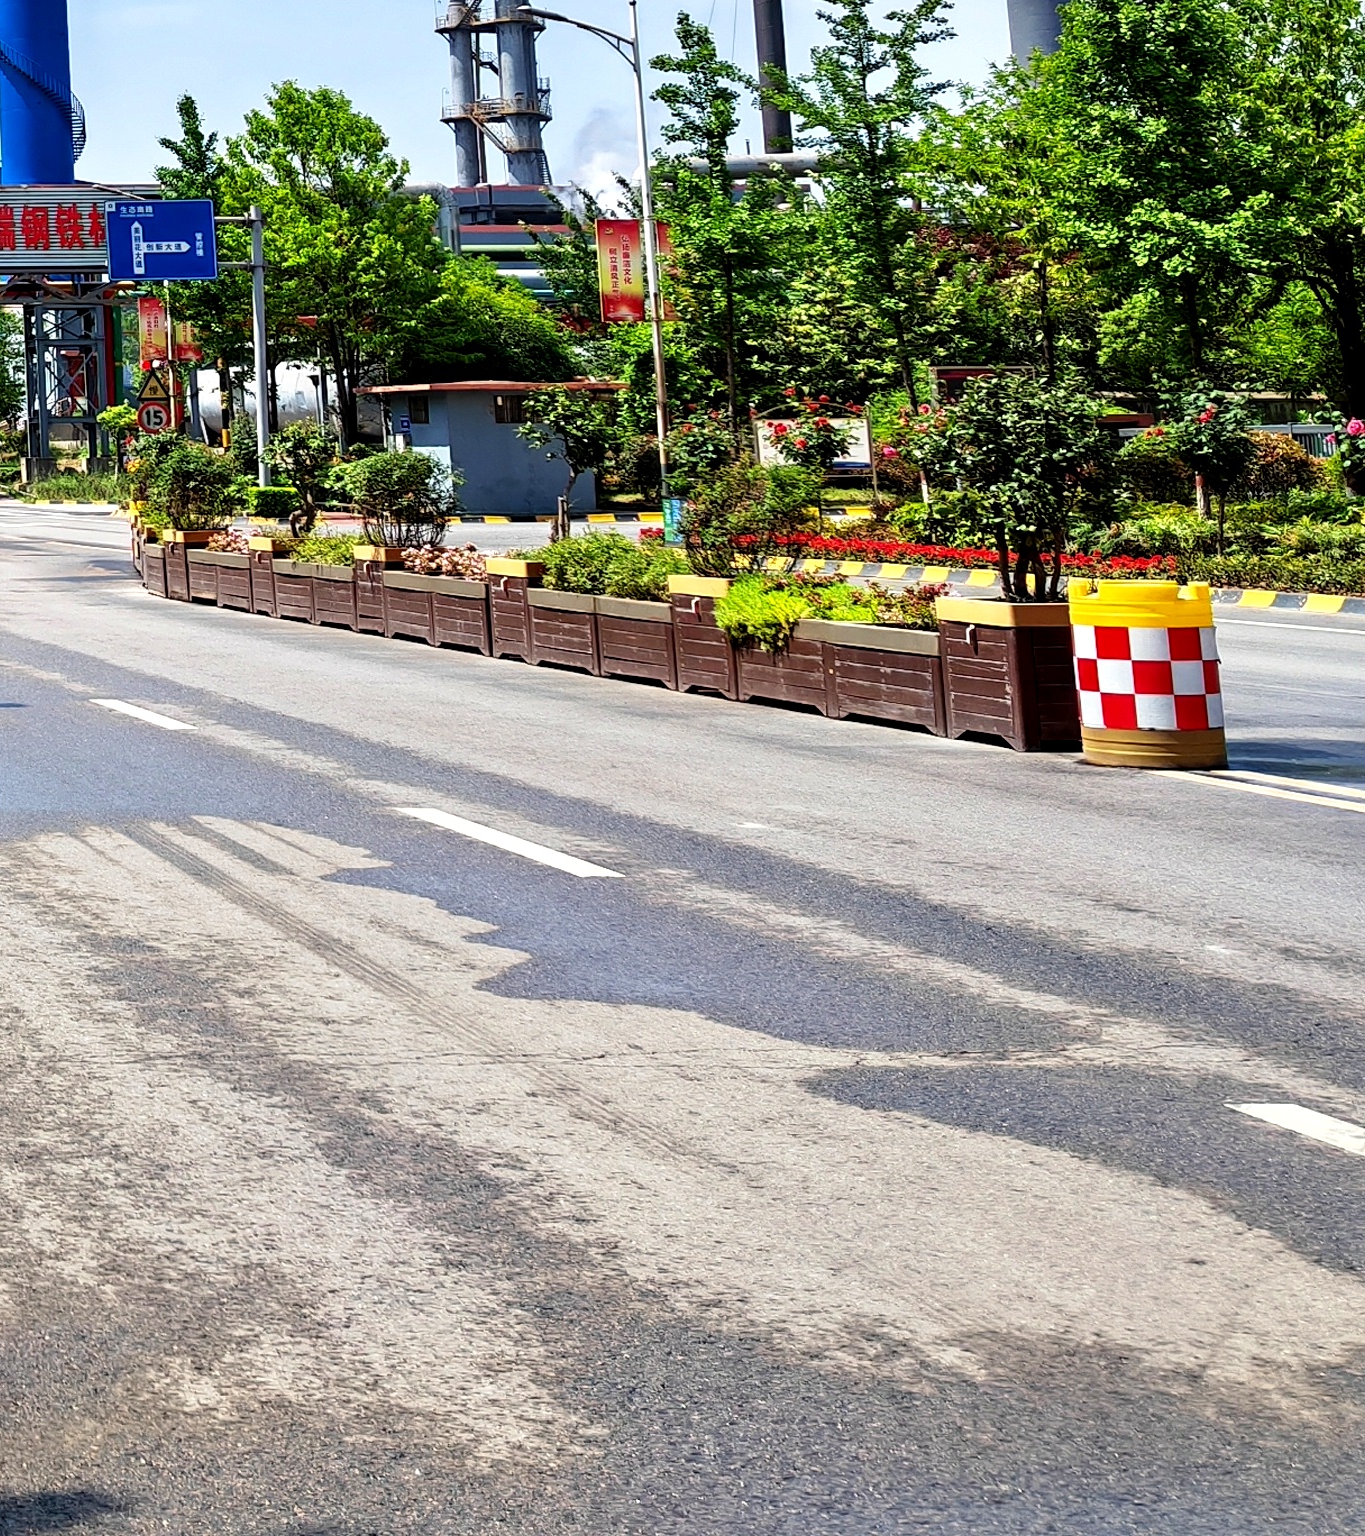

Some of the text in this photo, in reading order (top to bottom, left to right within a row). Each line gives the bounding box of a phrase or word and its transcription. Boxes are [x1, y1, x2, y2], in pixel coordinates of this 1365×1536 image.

[146, 243, 182, 251] 创新大道
[144, 409, 164, 427] 15
